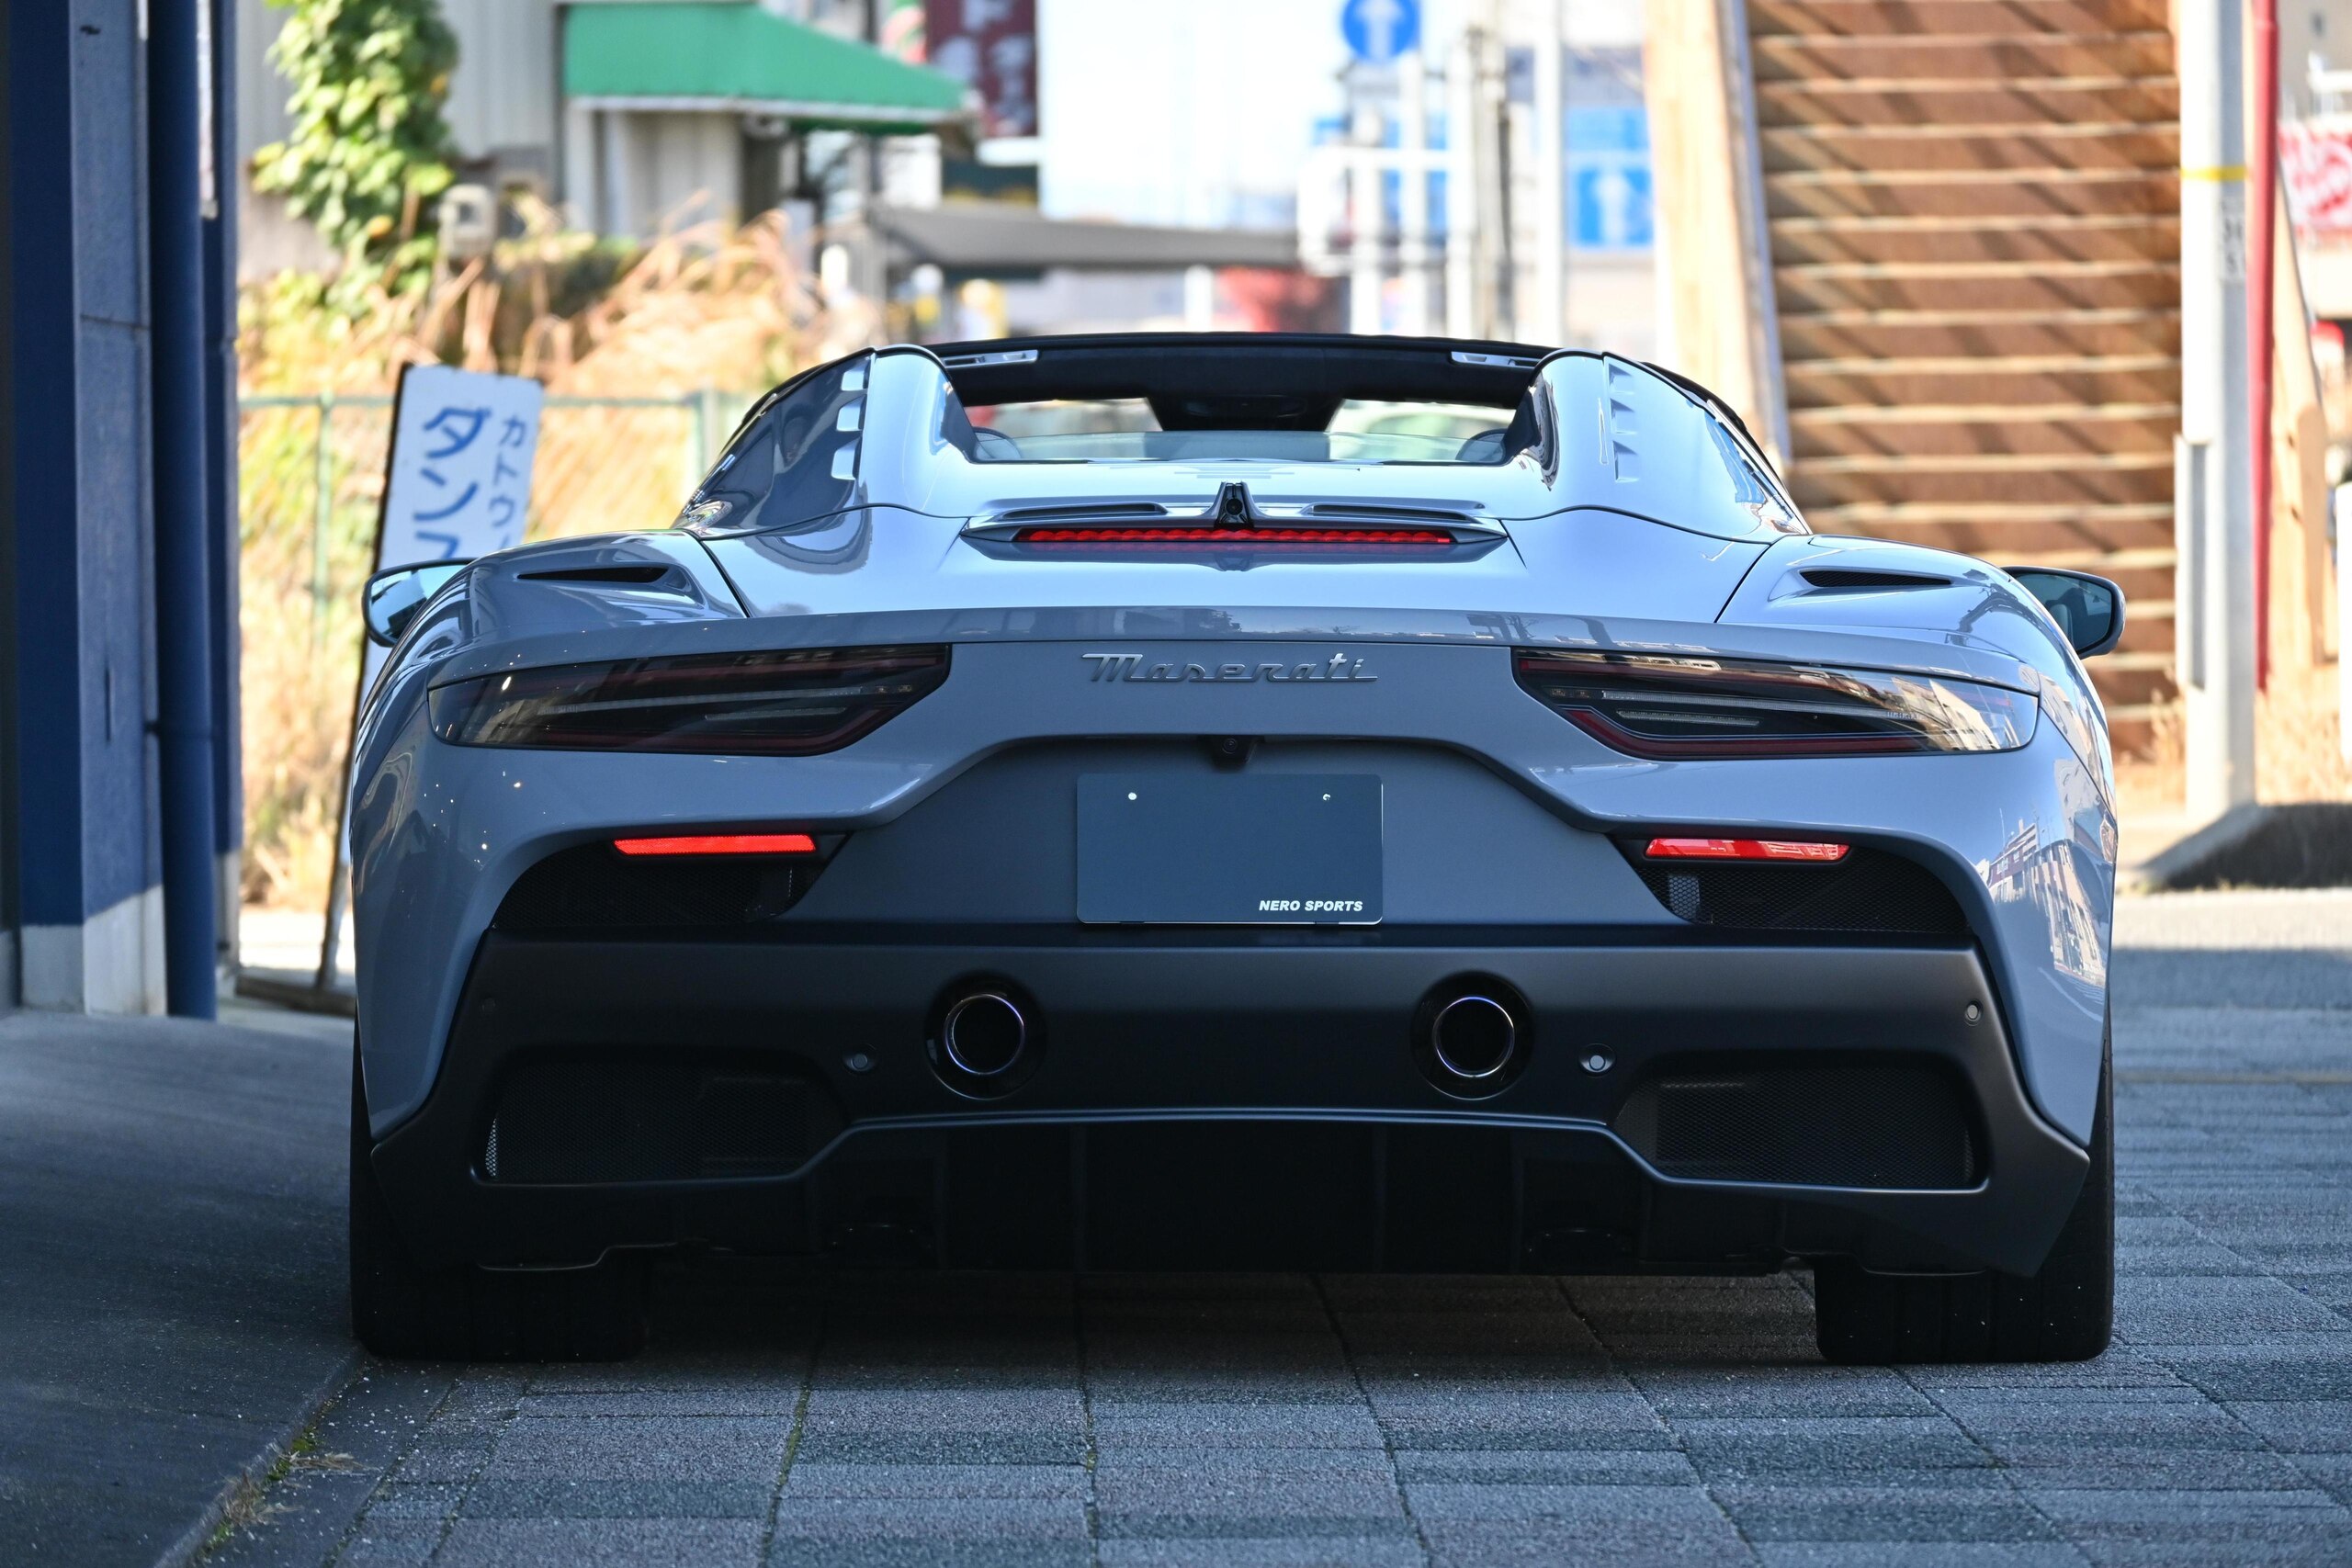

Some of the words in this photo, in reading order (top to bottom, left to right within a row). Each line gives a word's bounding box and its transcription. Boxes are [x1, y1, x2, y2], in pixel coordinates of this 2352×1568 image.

[1081, 652, 1378, 682] Maserati
[1259, 900, 1301, 911] NERO
[1305, 900, 1363, 912] SPORTS
